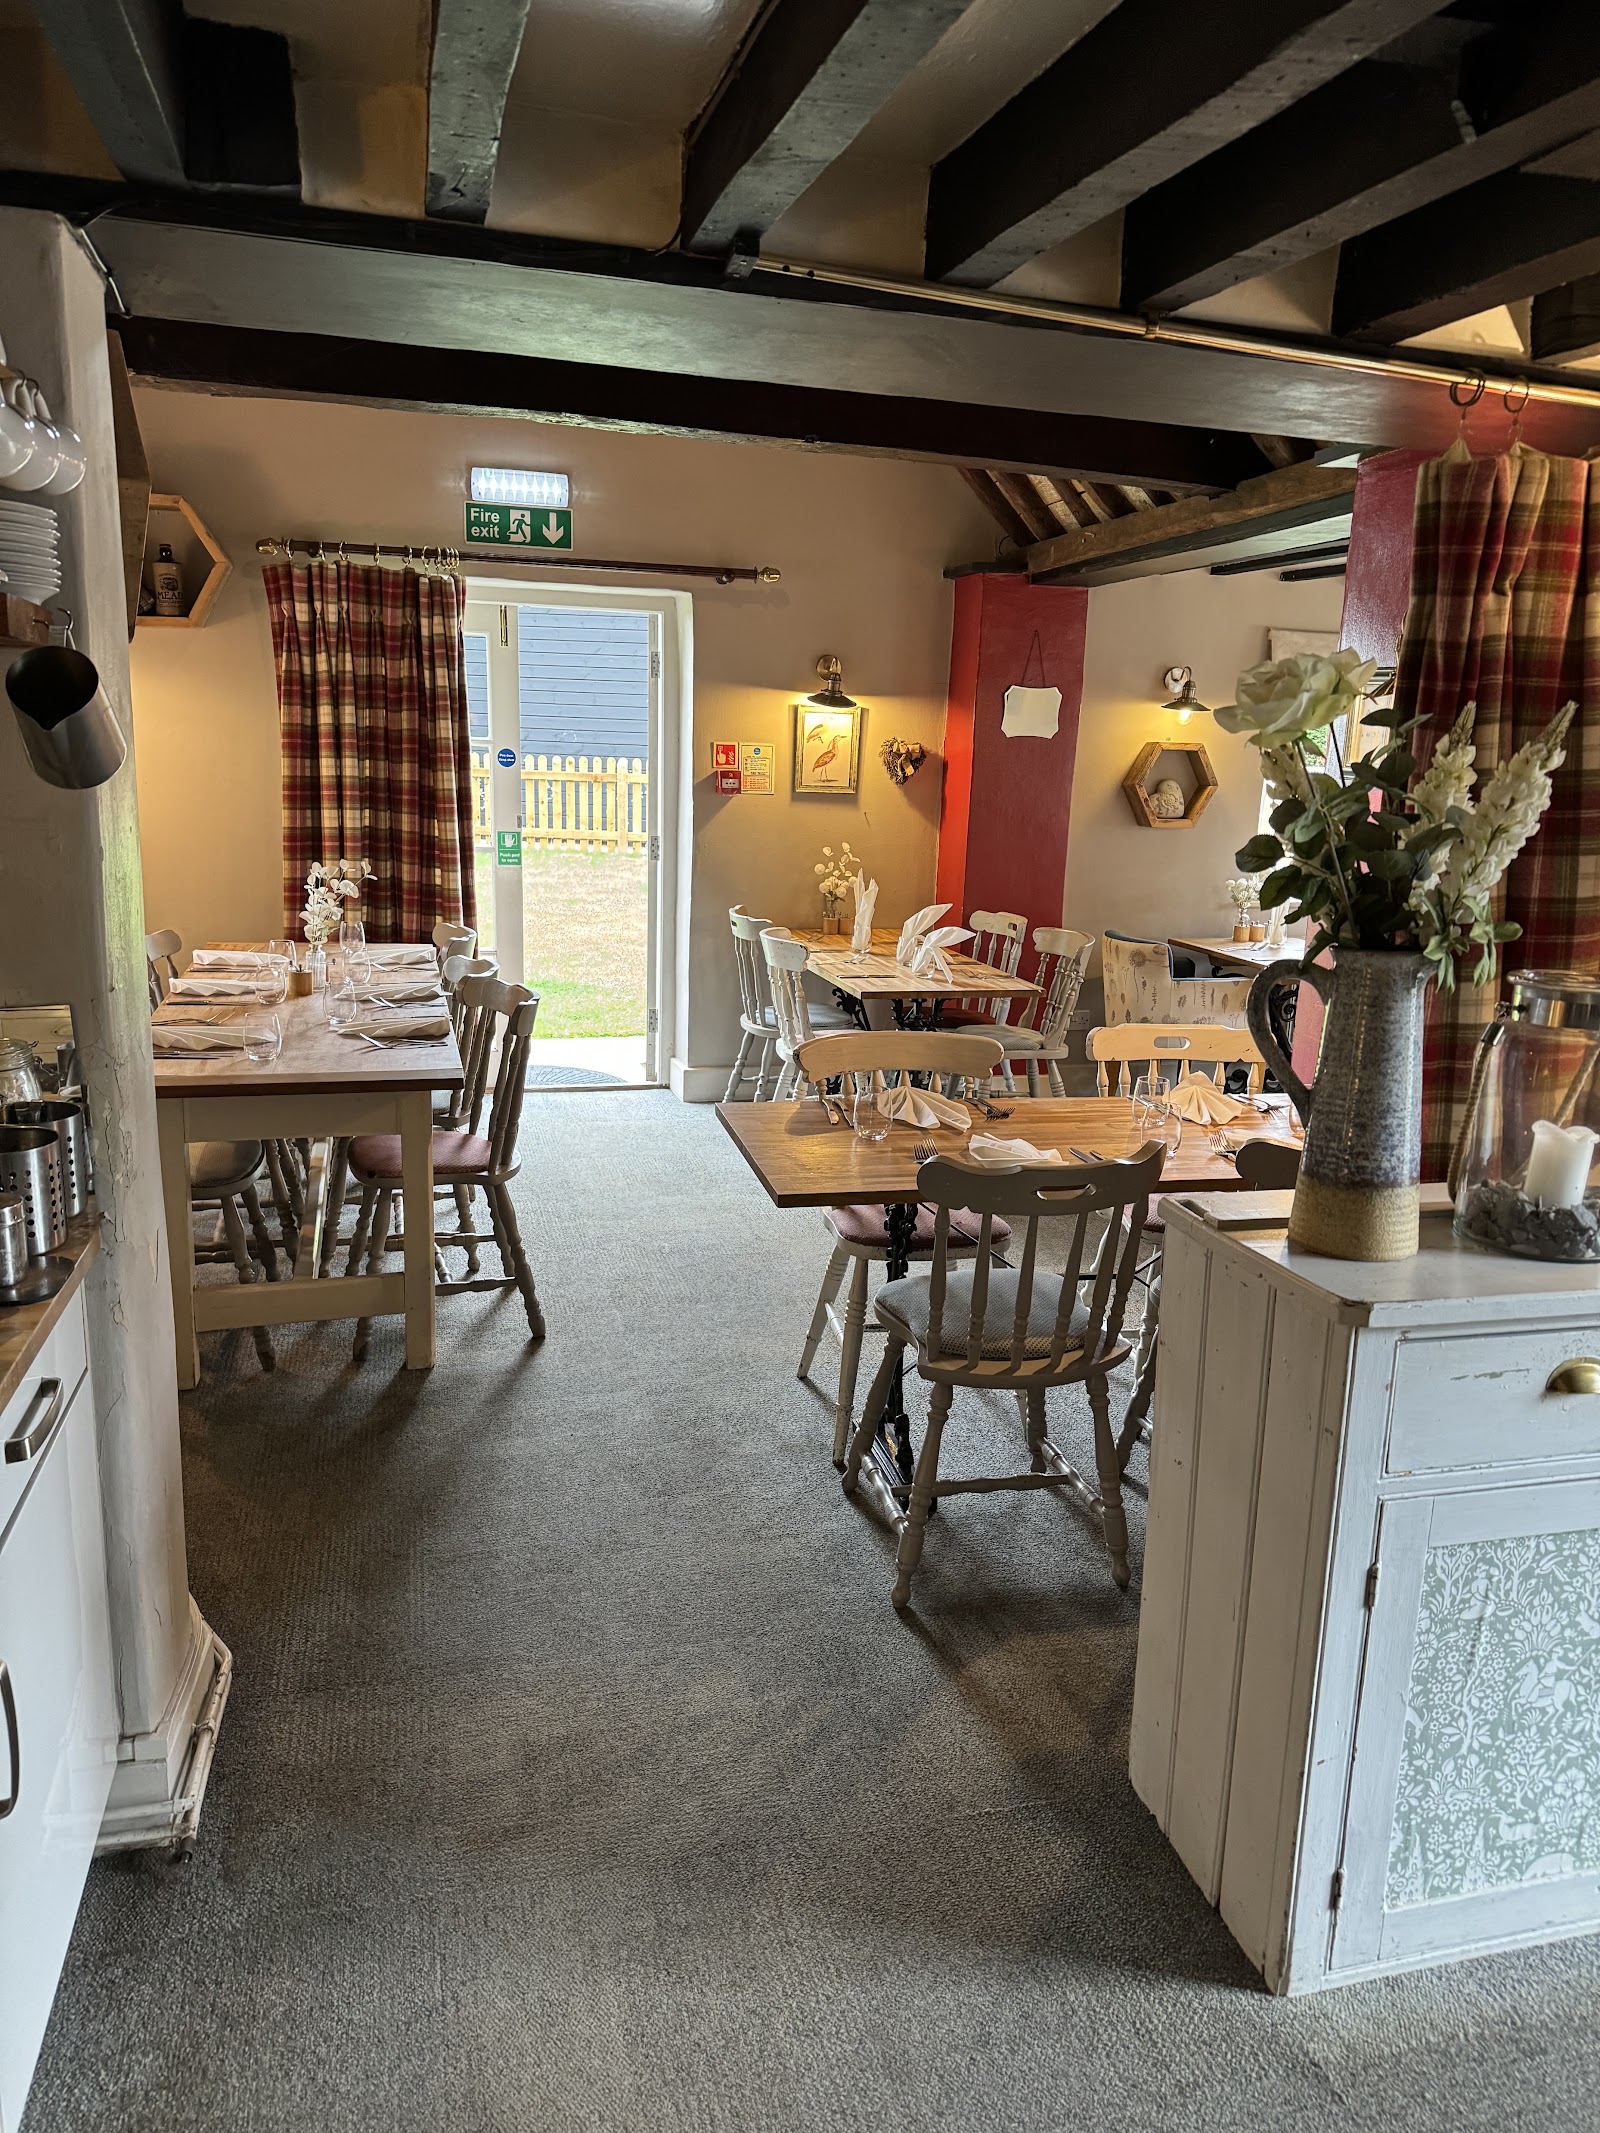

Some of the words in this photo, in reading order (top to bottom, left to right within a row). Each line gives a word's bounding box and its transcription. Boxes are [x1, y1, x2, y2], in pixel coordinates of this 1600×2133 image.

[470, 508, 500, 523] Fire
[471, 524, 500, 538] exit
[158, 591, 184, 600] MEAD
